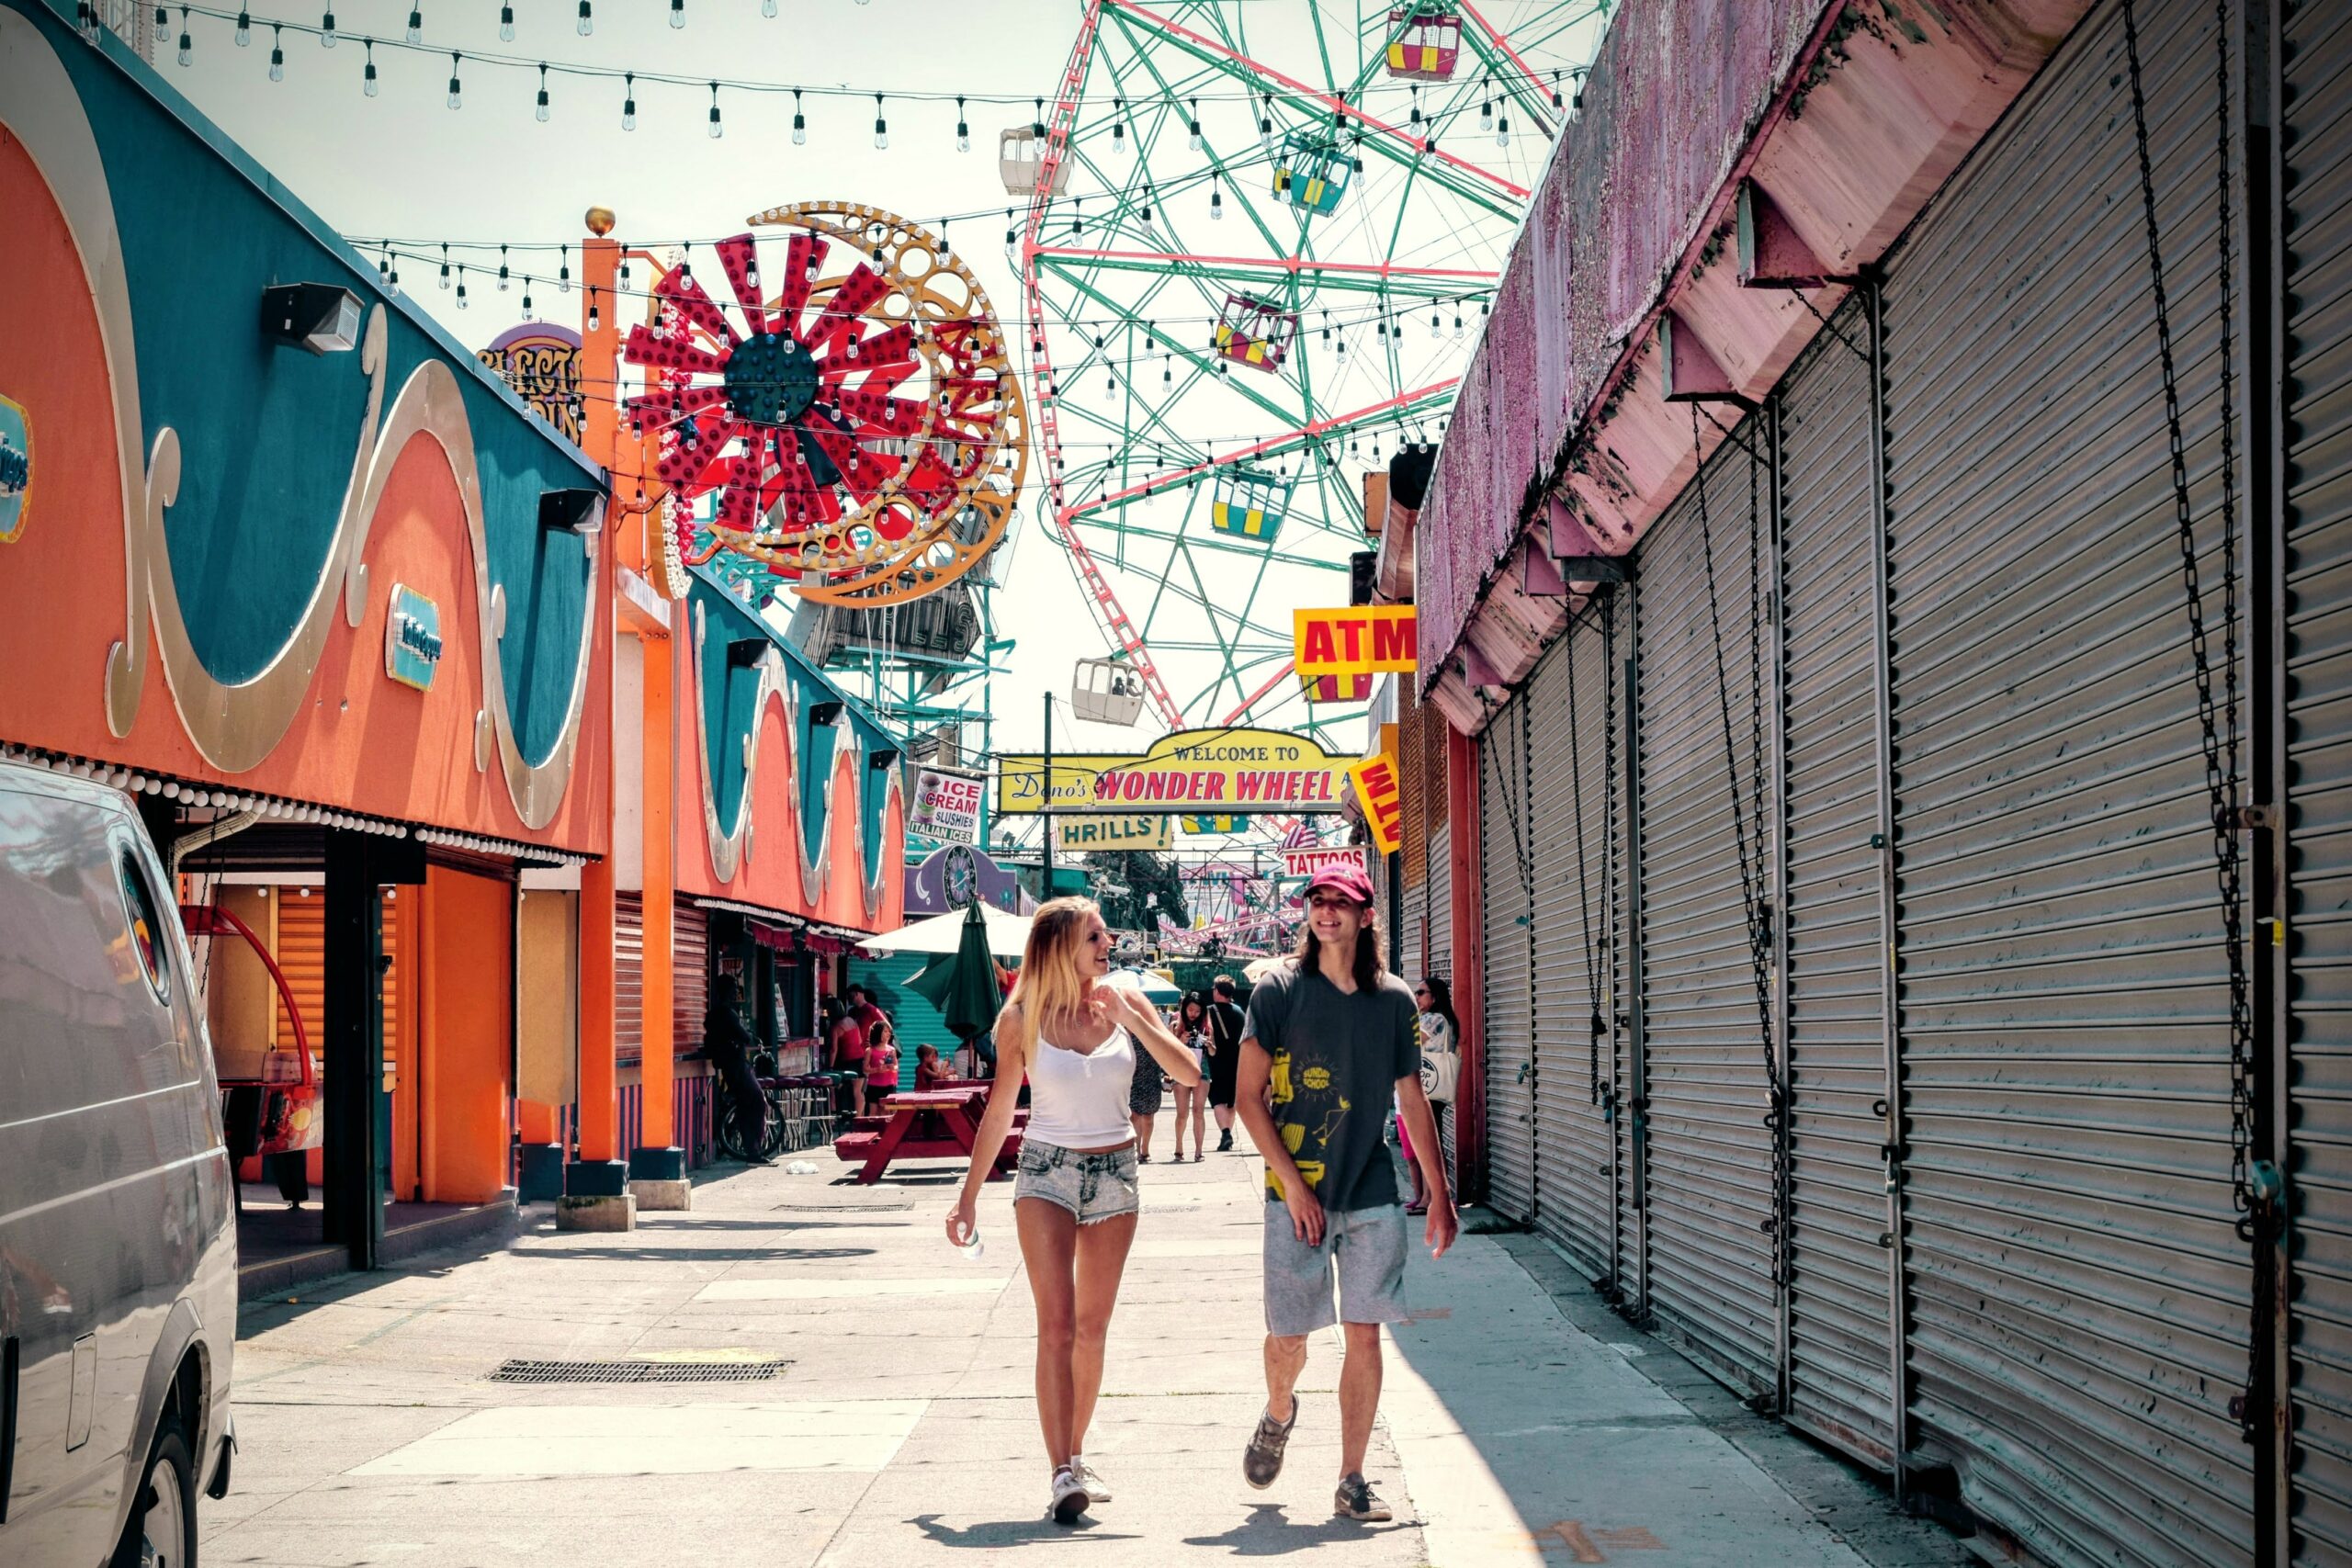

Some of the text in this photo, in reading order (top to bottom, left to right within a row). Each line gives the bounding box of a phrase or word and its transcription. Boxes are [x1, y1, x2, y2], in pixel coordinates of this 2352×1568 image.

[1304, 617, 1417, 663] ATM
[1175, 747, 1299, 761] WELCOME TO
[943, 780, 980, 799] ICE
[1095, 772, 1225, 801] WONDER
[1235, 772, 1333, 801] WHEEL
[925, 792, 978, 815] CREAM
[935, 810, 974, 828] SLUSHIES
[910, 820, 972, 843] ITALIAN ICES
[1303, 1066, 1330, 1077] SUNDAY
[1303, 1078, 1330, 1089] SCHOOL
